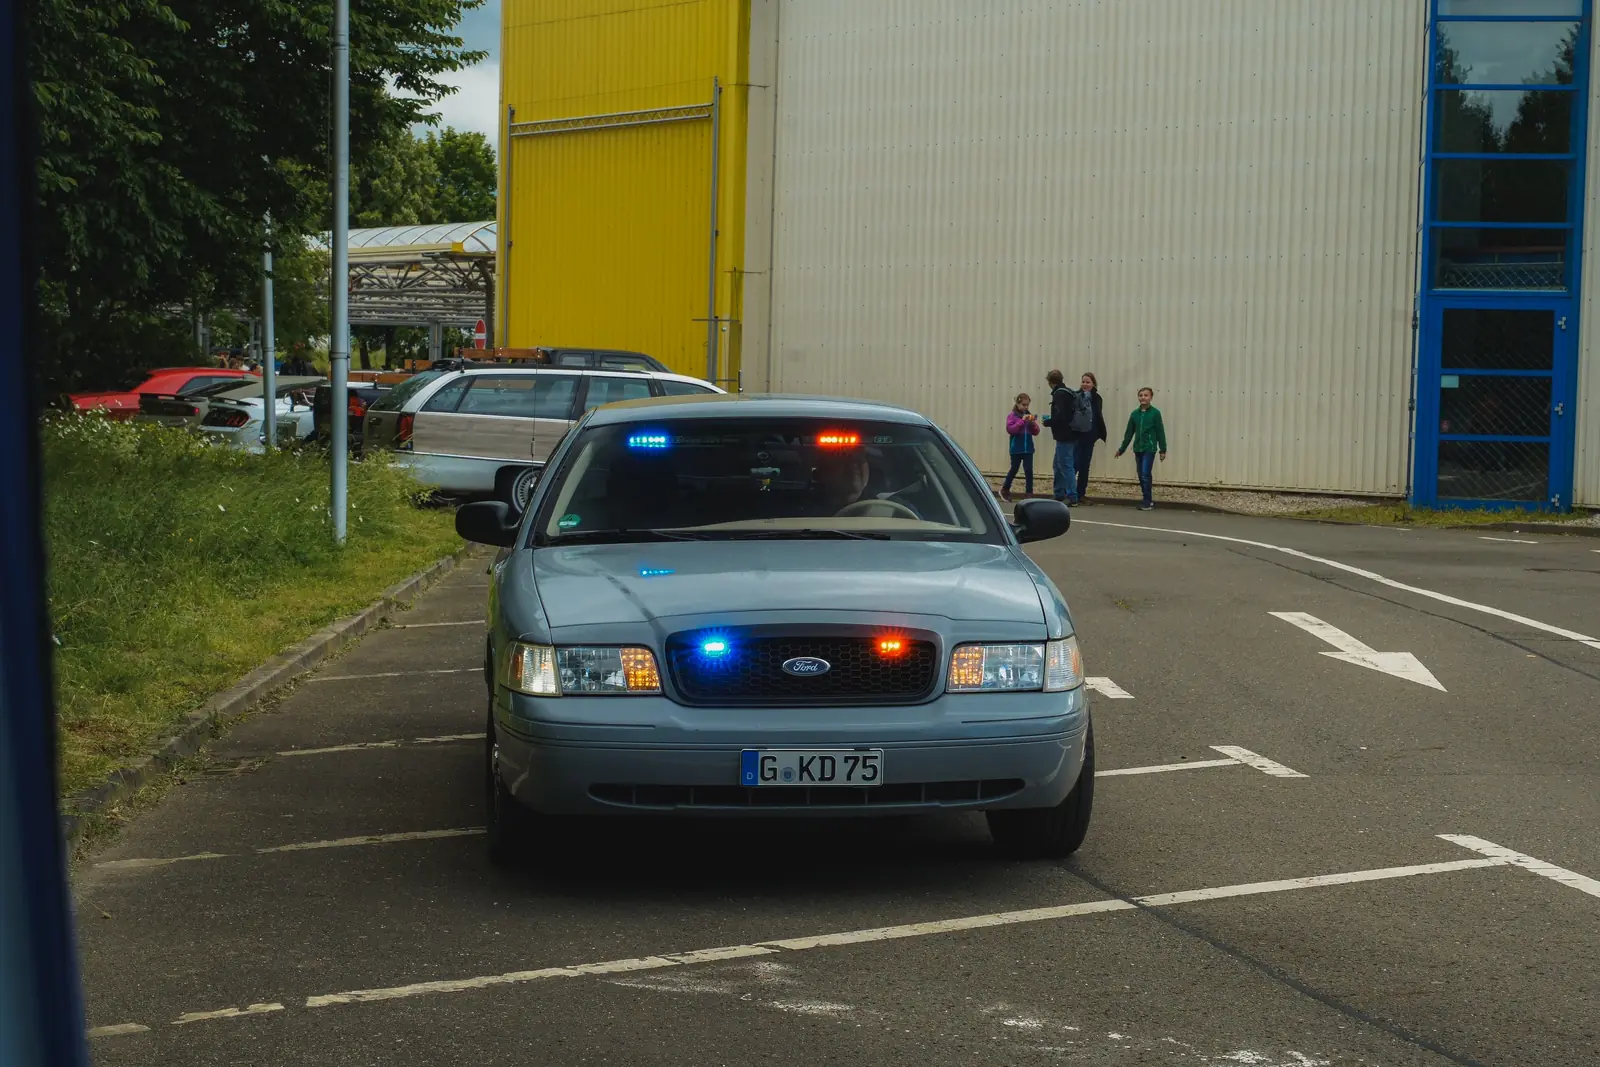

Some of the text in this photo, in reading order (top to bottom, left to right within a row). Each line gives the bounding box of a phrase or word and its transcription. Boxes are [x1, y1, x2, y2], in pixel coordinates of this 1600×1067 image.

[793, 661, 818, 672] Ford
[760, 755, 879, 782] G KD 75
[746, 772, 754, 780] D
